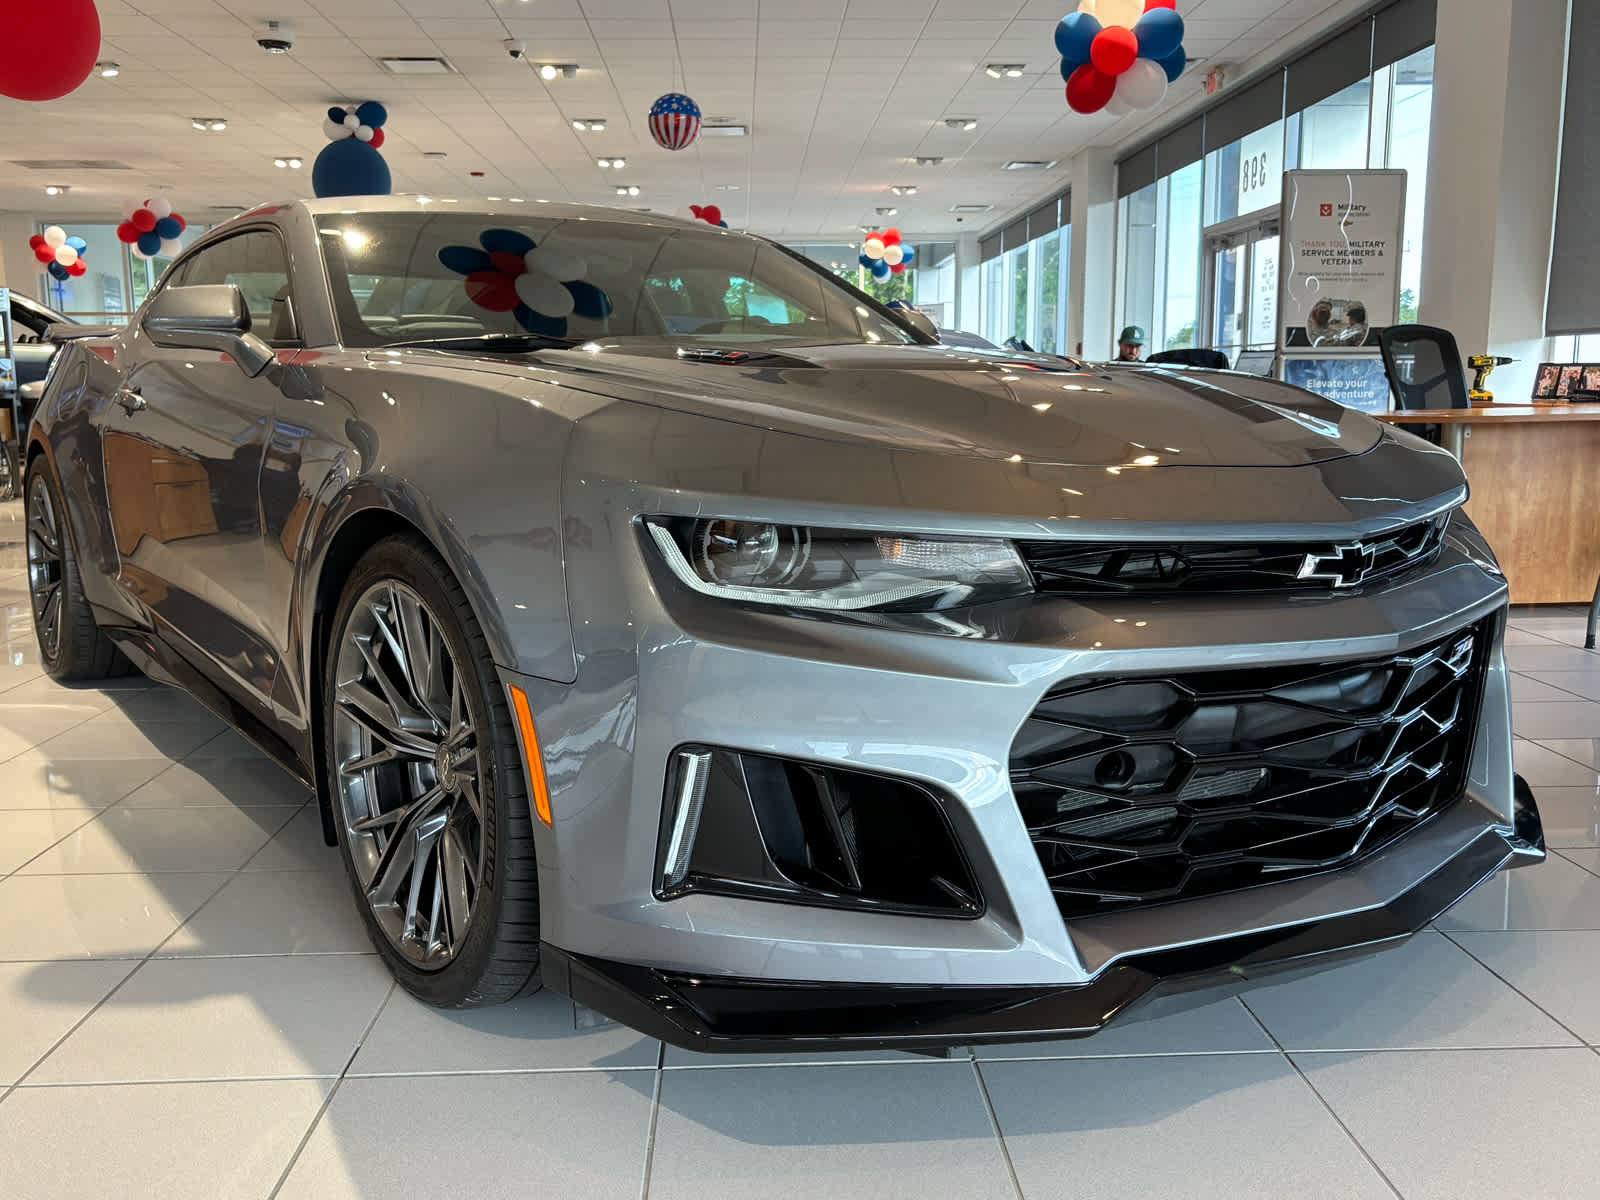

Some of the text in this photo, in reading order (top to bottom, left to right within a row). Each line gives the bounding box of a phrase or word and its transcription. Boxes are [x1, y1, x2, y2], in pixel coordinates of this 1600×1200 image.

[1338, 203, 1366, 211] Miltary
[1301, 249, 1335, 257] SERVICE
[1337, 249, 1375, 257] MEMBERS
[1307, 379, 1368, 390] Elevate your
[1324, 389, 1375, 400] adventure
